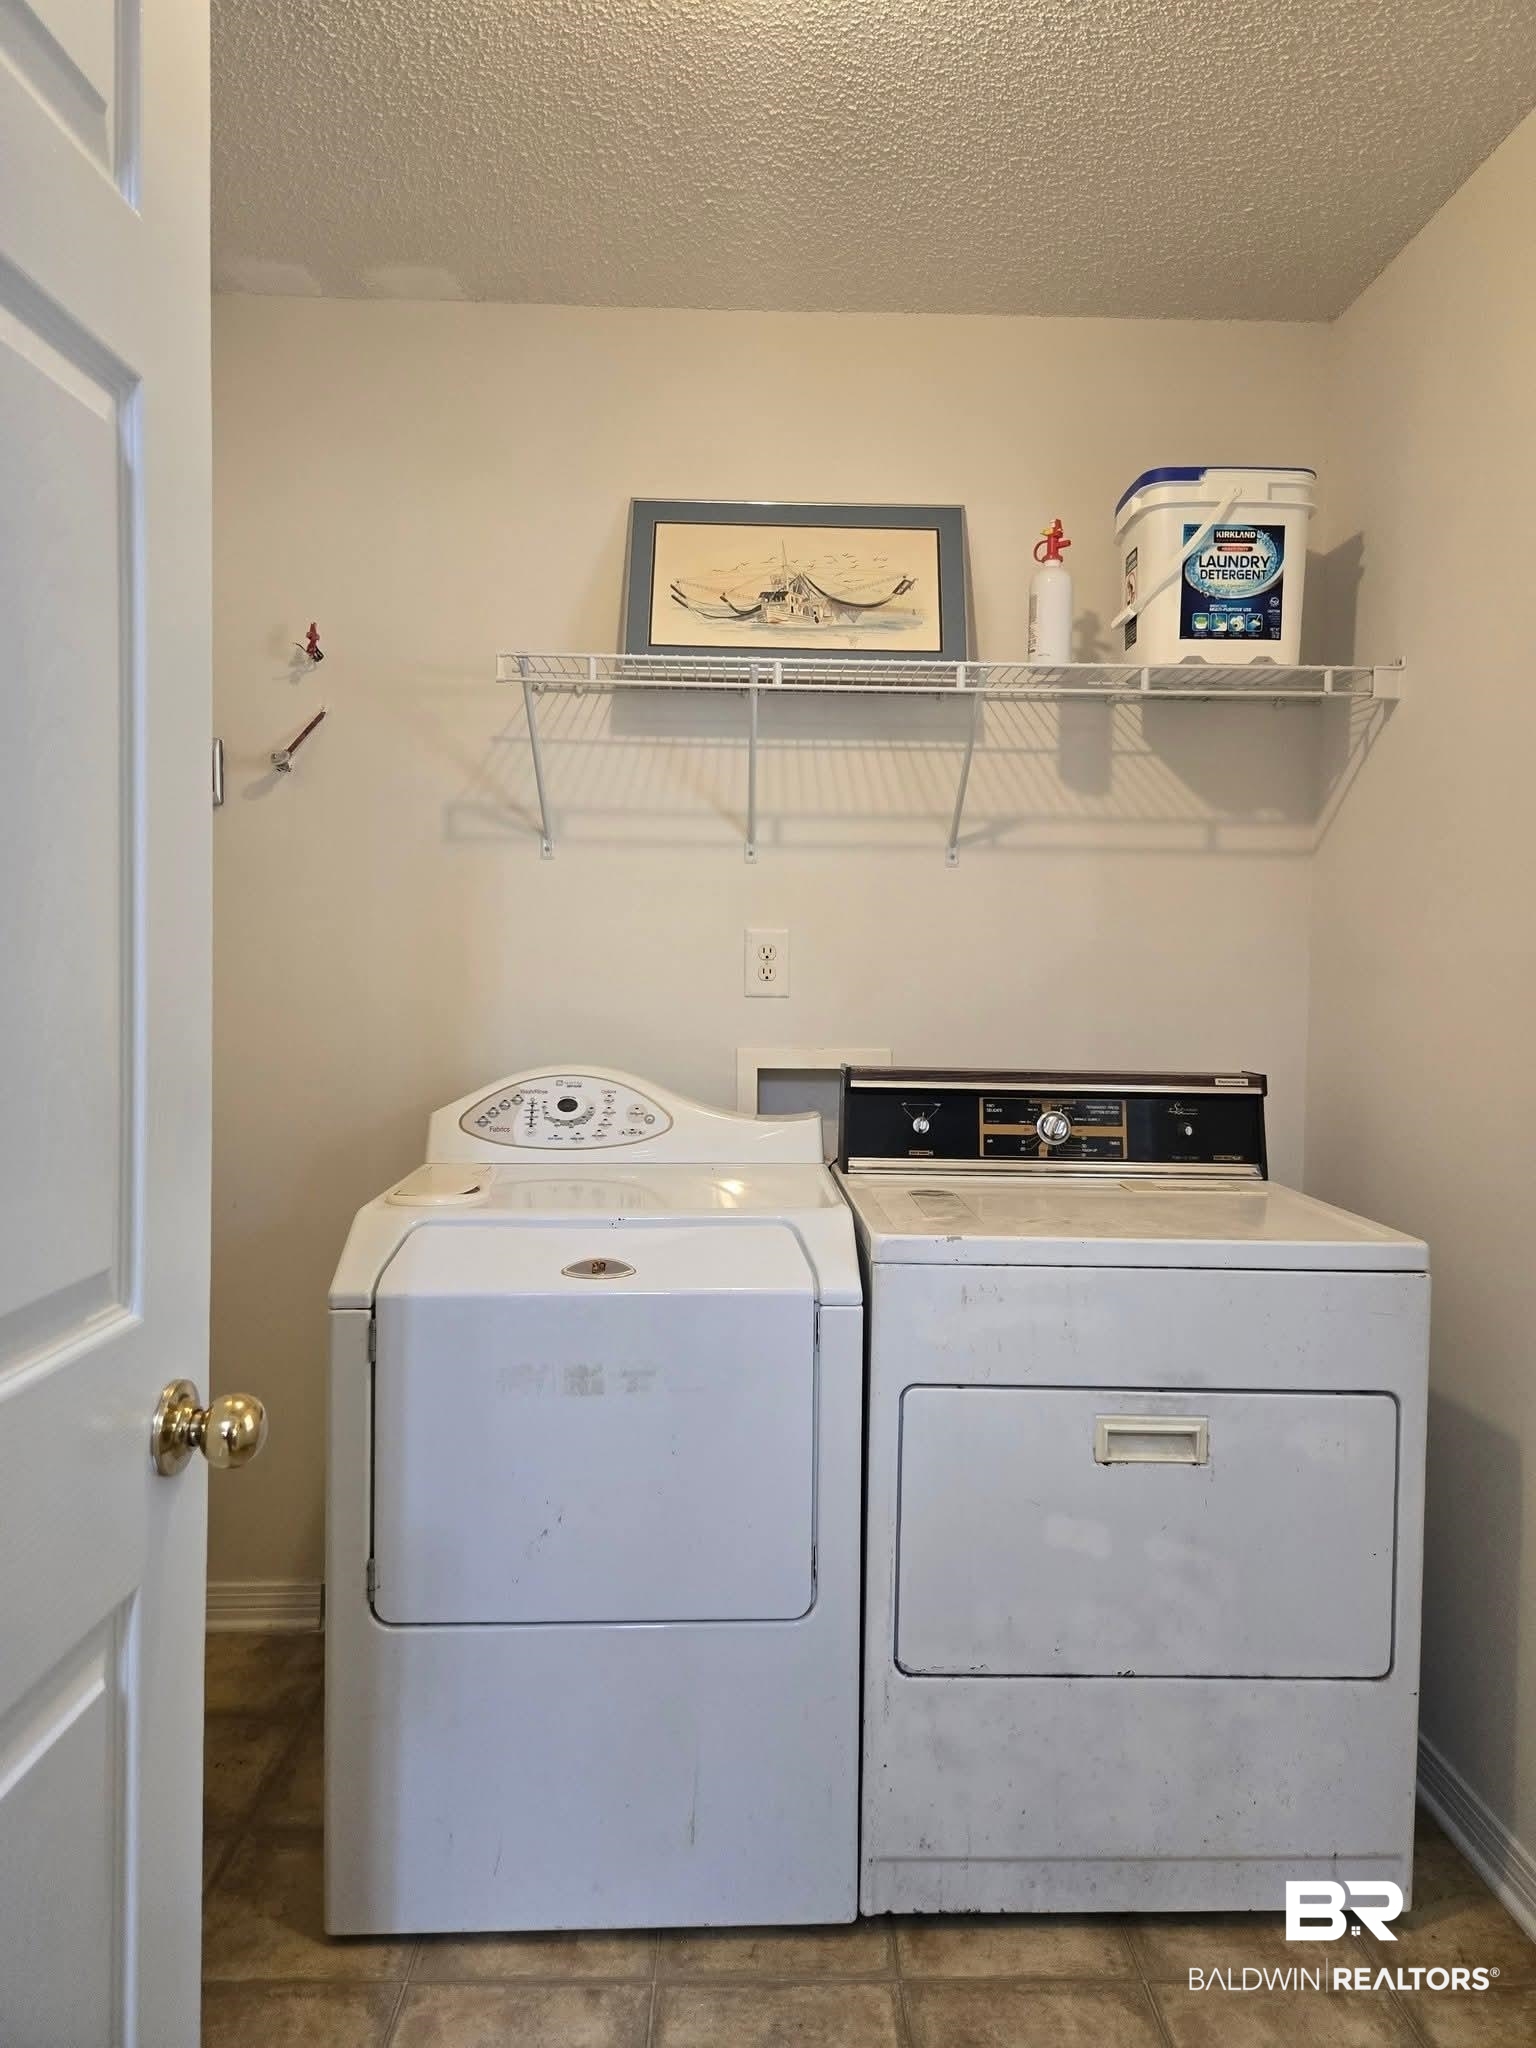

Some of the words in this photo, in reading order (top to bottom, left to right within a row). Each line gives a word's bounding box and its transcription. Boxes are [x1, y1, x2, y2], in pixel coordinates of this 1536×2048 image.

[1216, 531, 1256, 539] KIRKLAND
[1199, 555, 1270, 568] LAUNDRY
[1200, 569, 1267, 580] DETERGENT
